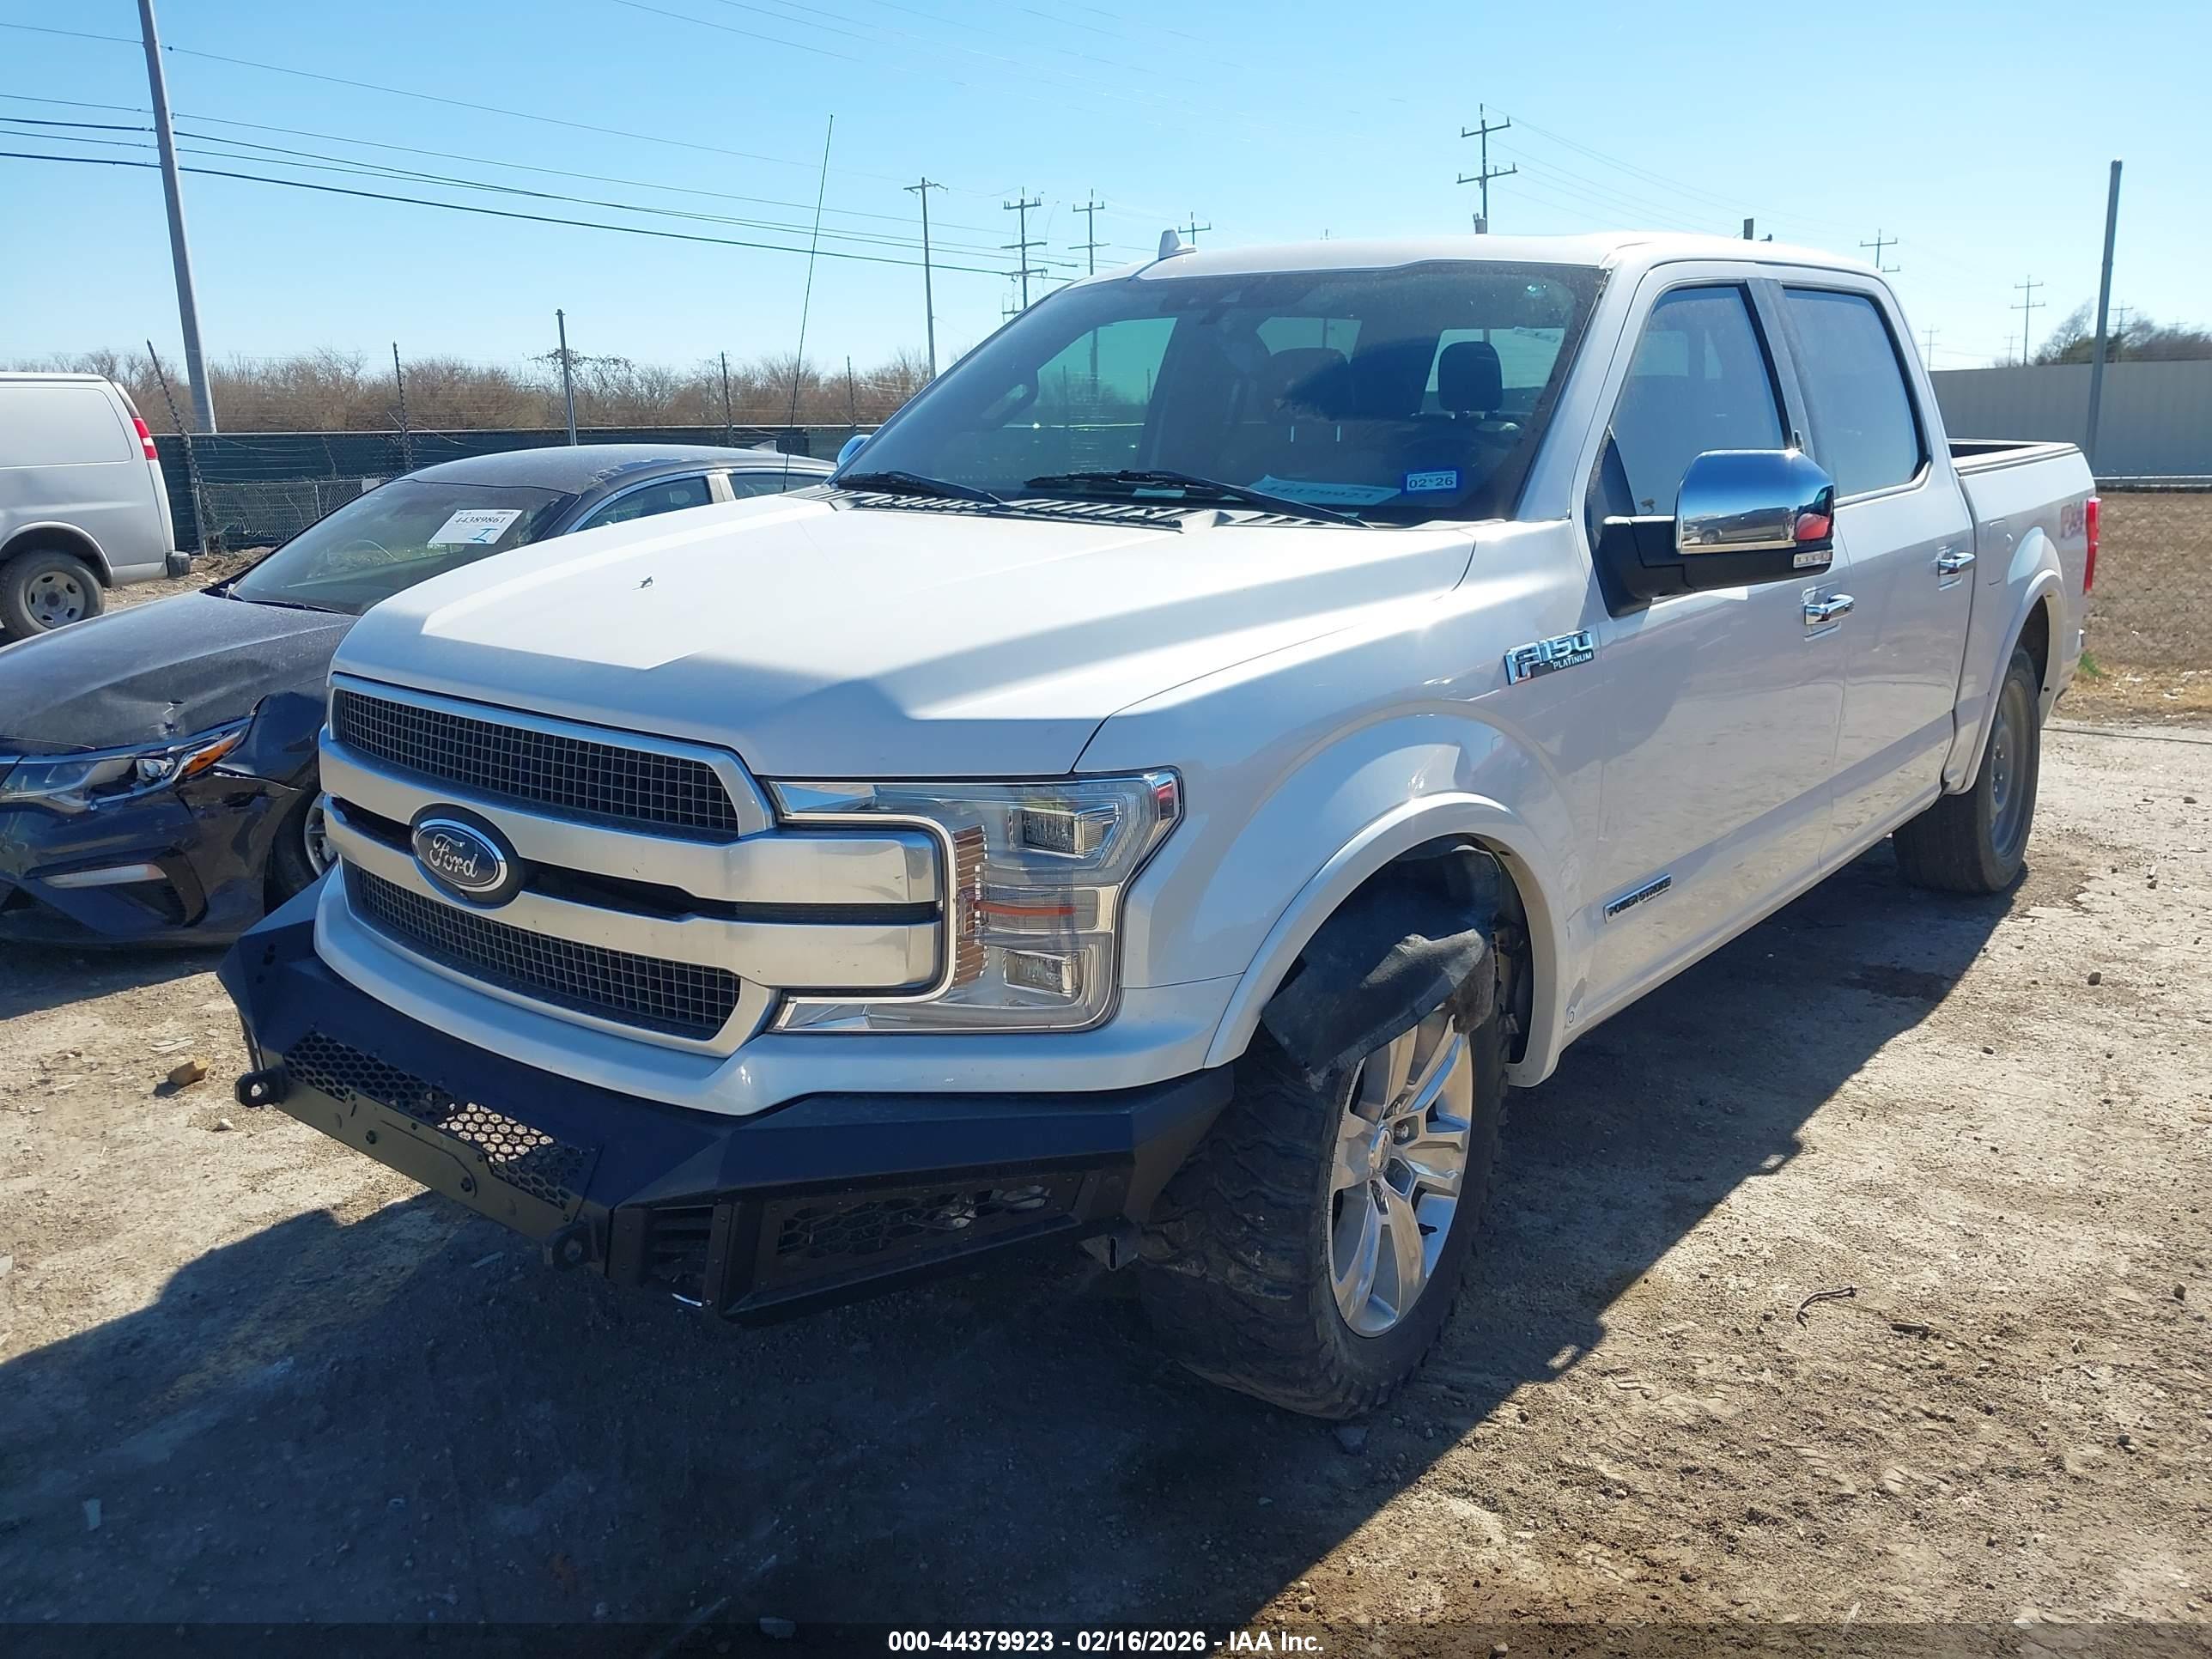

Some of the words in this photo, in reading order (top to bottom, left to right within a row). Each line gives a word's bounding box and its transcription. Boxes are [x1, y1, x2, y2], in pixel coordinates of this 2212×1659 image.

[1409, 478, 1427, 488] 02
[1435, 477, 1454, 486] 26
[1553, 651, 1593, 670] PLATINUM
[429, 833, 478, 878] Ford
